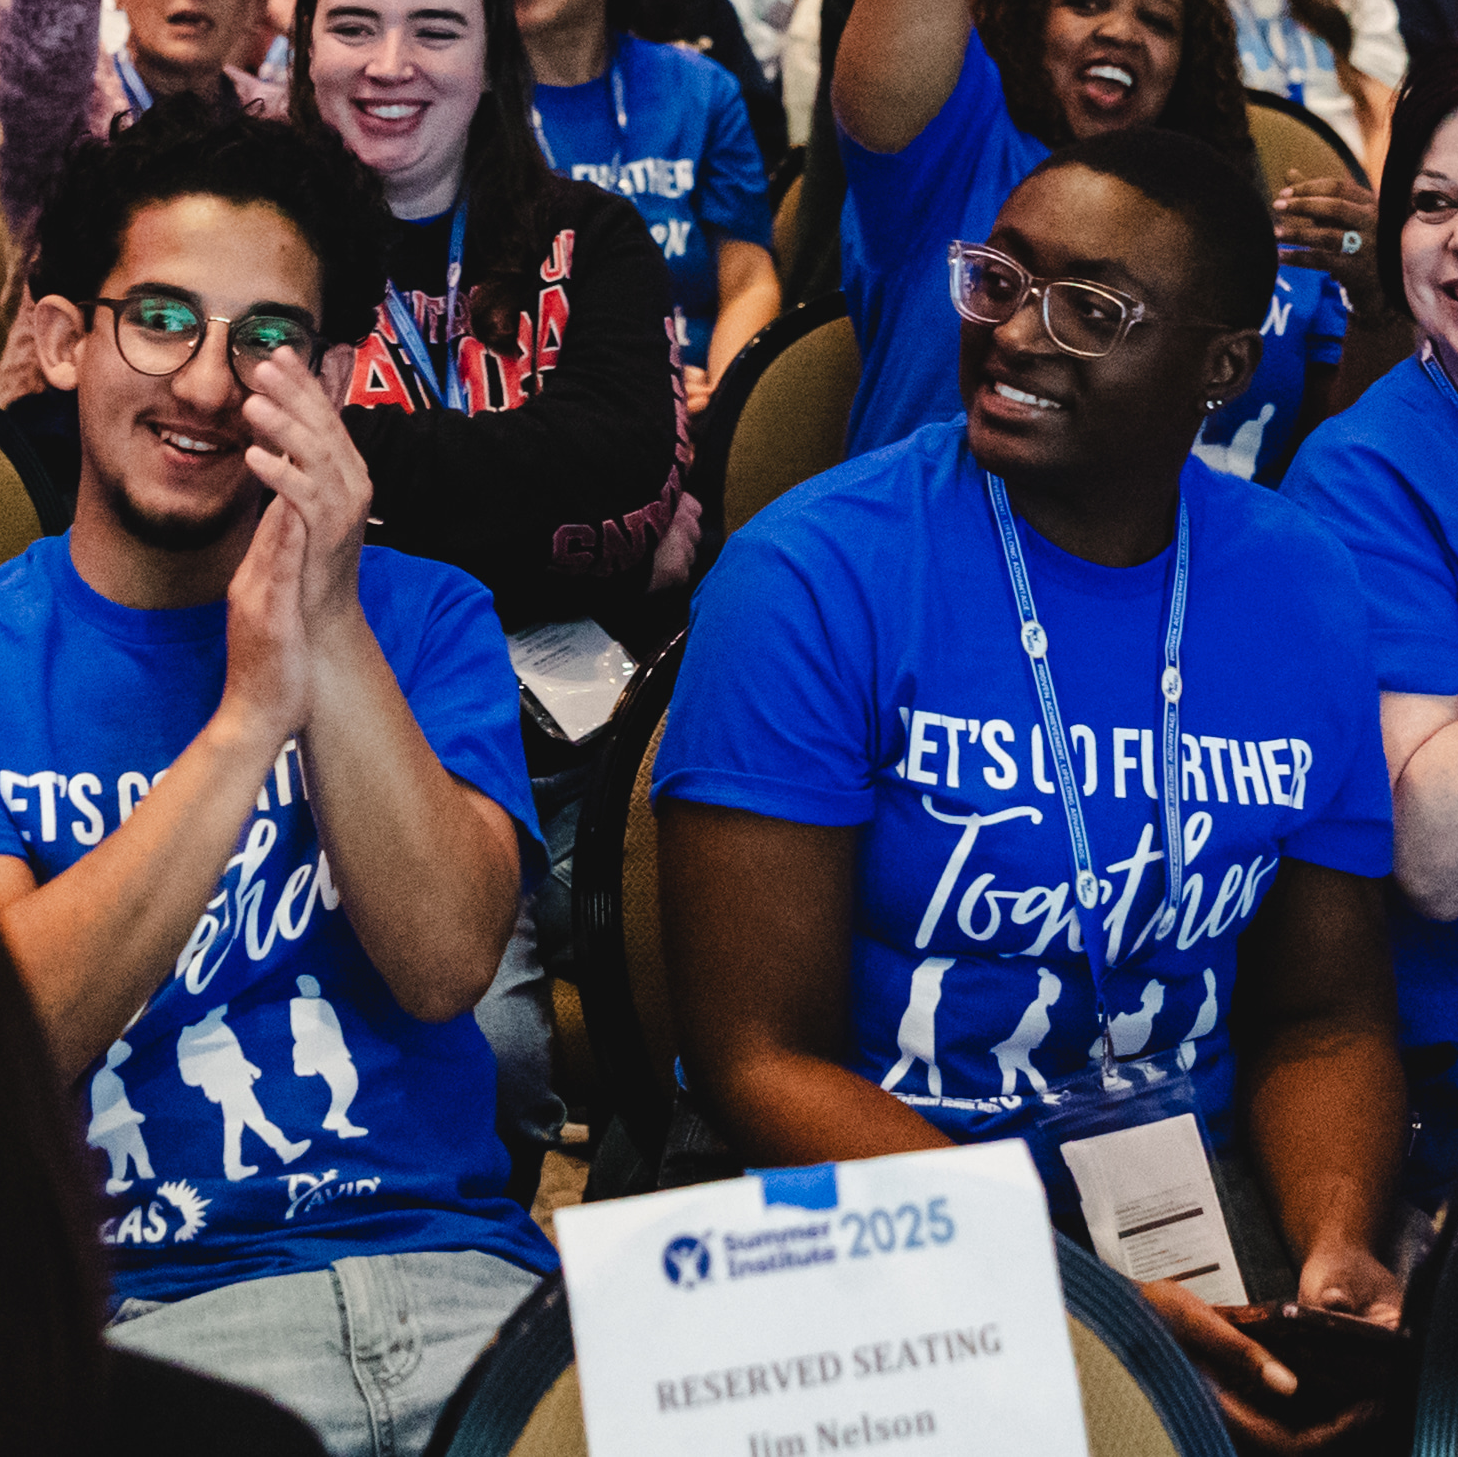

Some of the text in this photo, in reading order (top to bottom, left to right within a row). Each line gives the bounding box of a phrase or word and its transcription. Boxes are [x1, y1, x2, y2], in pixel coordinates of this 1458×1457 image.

[896, 707, 1019, 790] ET'S
[0, 769, 104, 845] ET'S
[722, 1196, 955, 1260] Summer 2025
[727, 1243, 837, 1281] Institute
[656, 1324, 1002, 1414] RESERVED SEATING
[815, 1408, 936, 1454] Nelson
